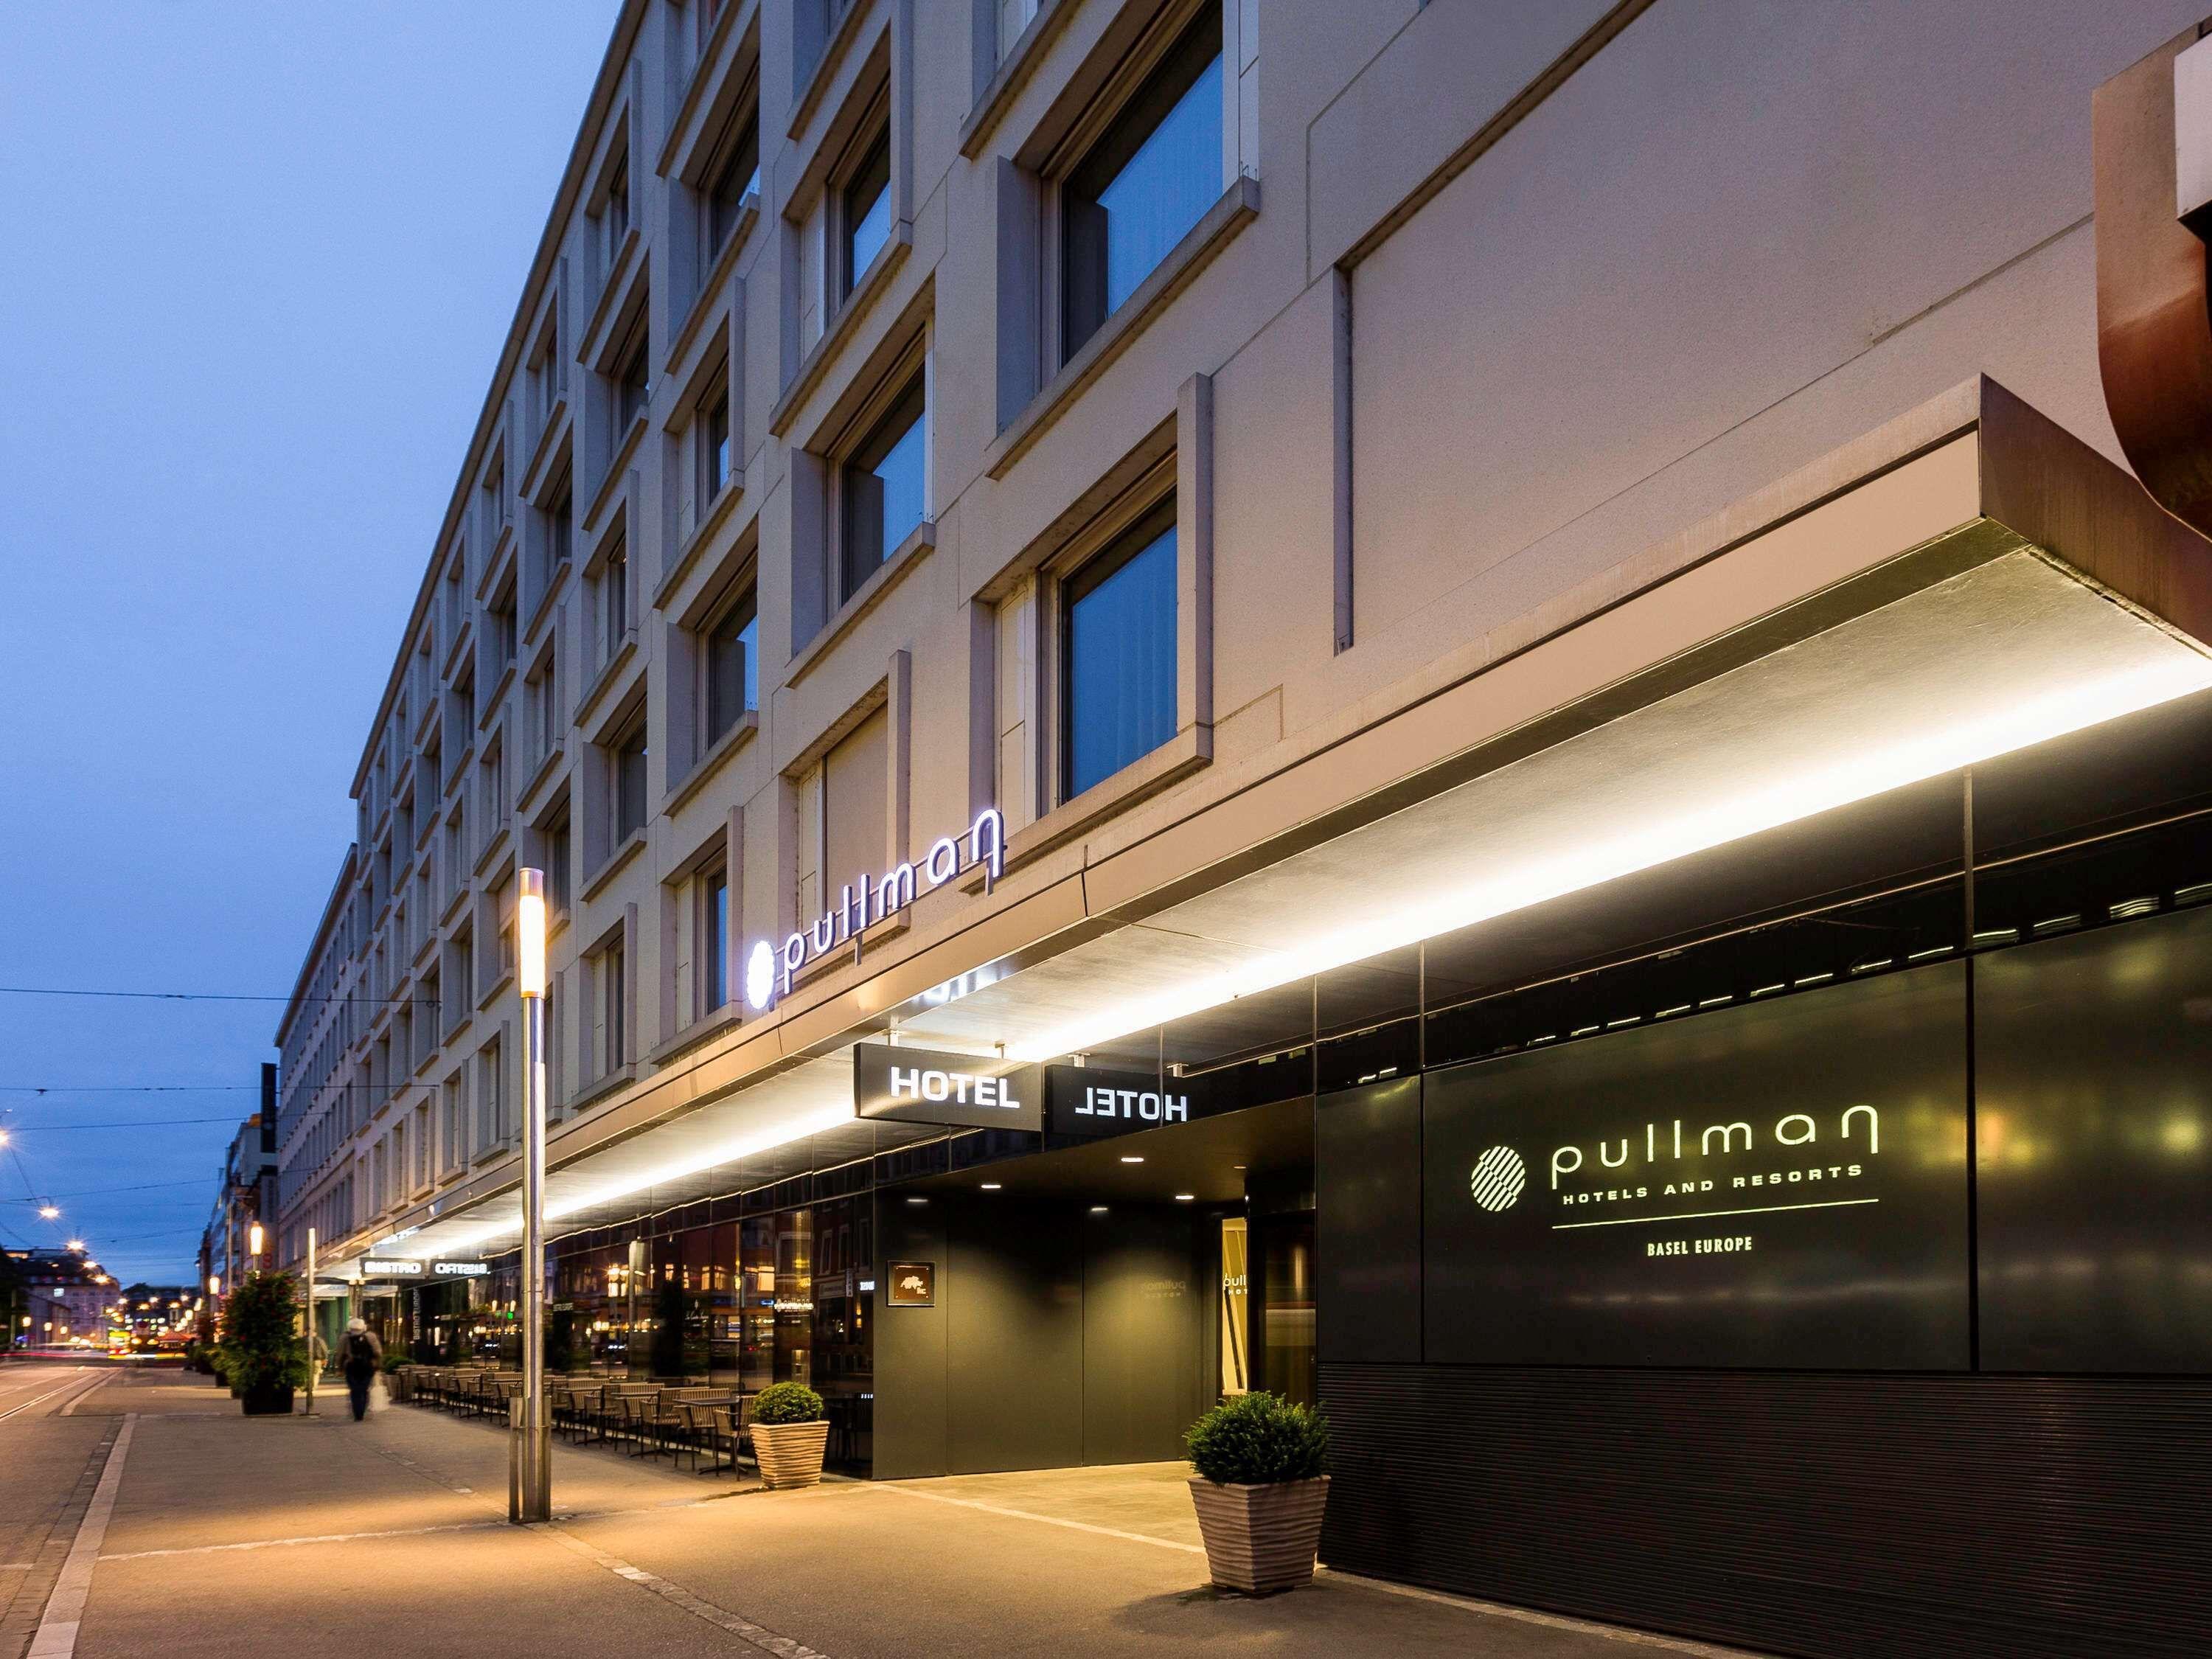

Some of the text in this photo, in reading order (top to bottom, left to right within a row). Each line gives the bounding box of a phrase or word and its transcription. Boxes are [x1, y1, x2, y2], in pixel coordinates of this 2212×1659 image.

[782, 808, 1005, 995] pullman
[890, 1066, 1020, 1109] HOTEL
[1551, 1105, 1879, 1190] pullman
[1562, 1164, 1864, 1206] HOTELS AND RESORTS
[1646, 1237, 1753, 1257] BASEL EUROPE
[1222, 1274, 1247, 1290] pull
